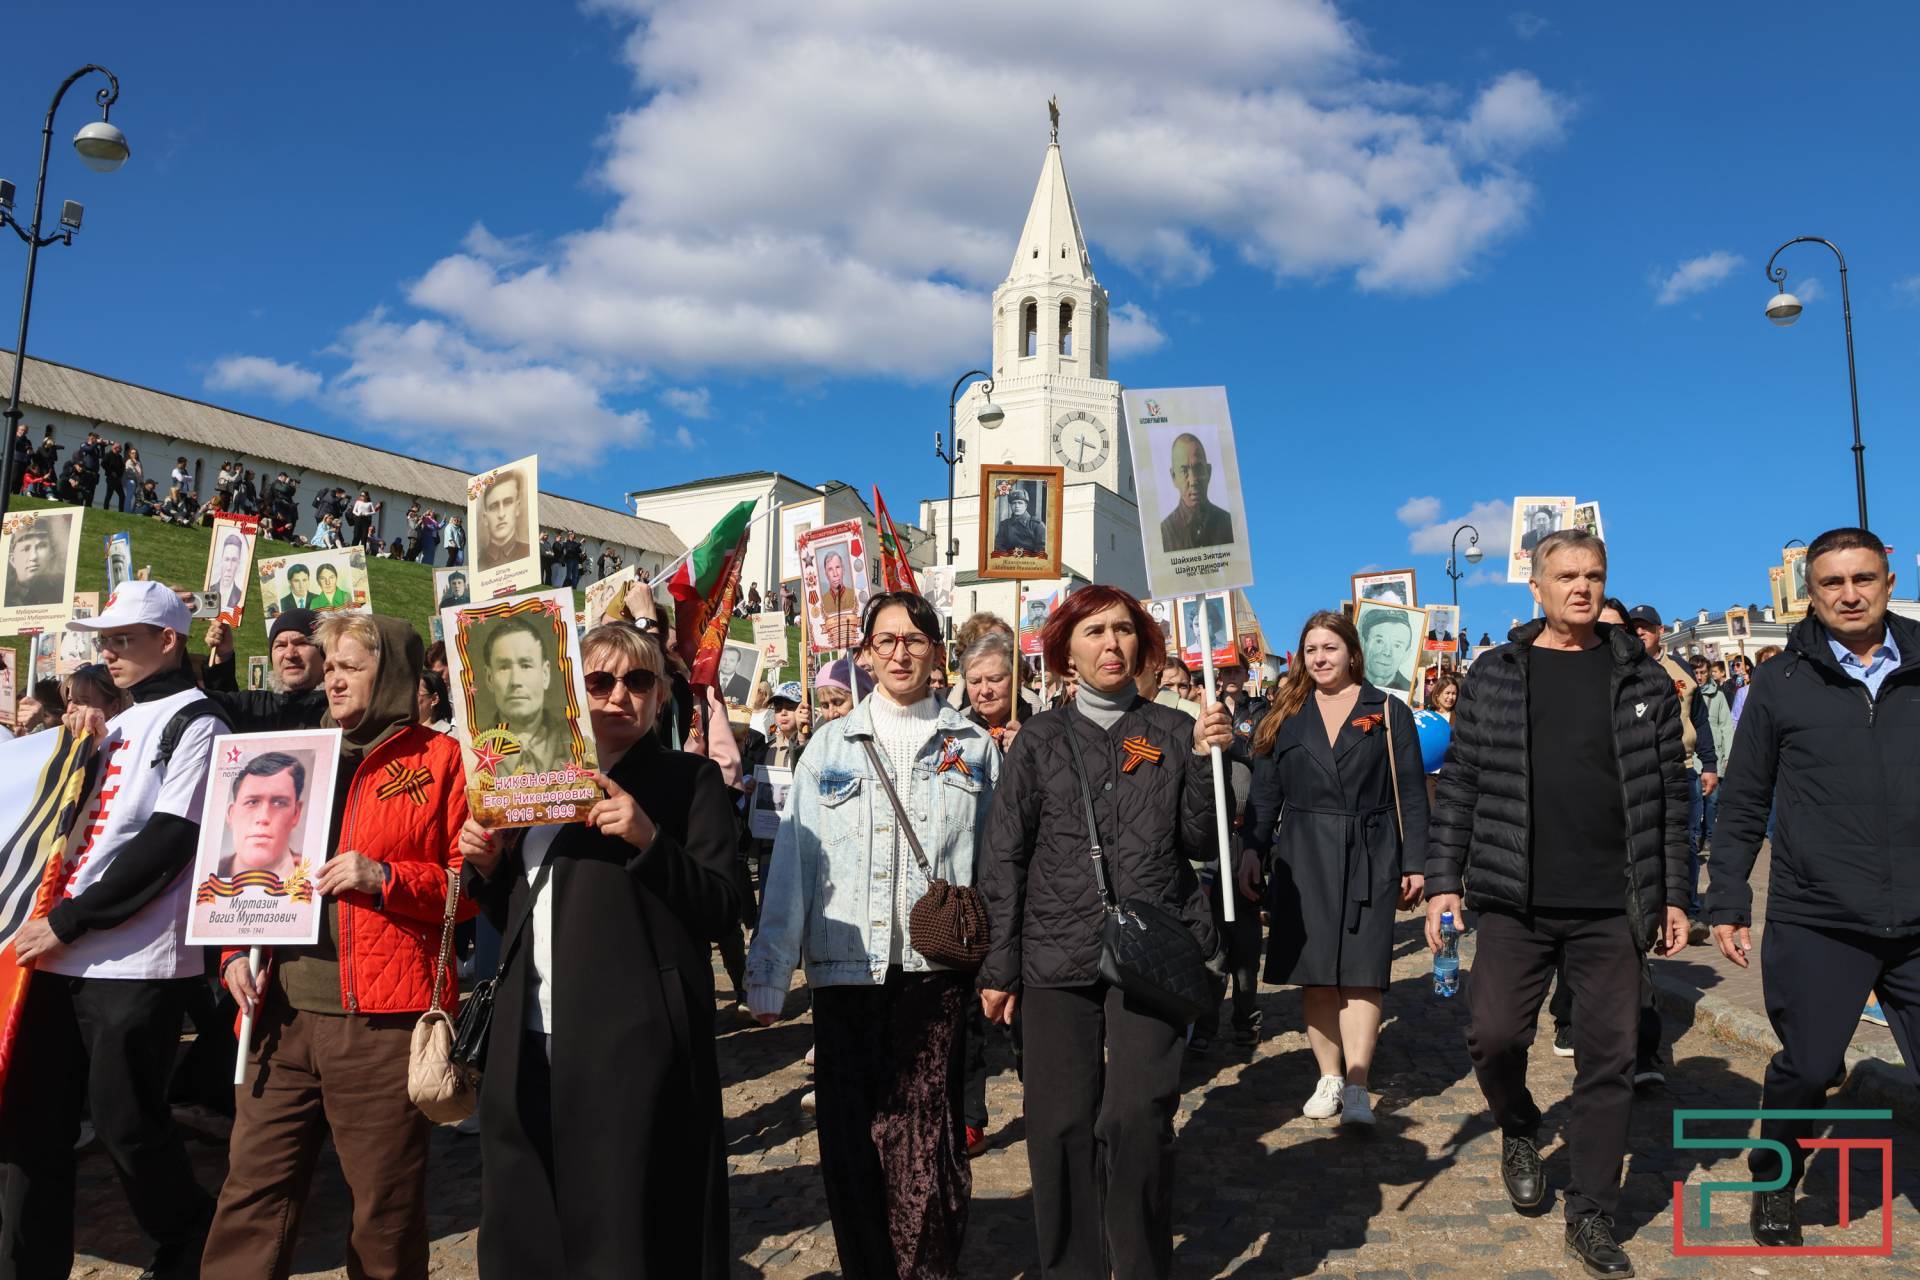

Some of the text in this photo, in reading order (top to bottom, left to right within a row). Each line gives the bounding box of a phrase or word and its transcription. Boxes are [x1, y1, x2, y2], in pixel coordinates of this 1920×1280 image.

[1171, 556, 1202, 565] Шайхиев
[1175, 561, 1229, 574] Шайхутдинович
[494, 771, 576, 790] НИКОНОРОВ
[483, 788, 594, 808] Егор Никонорович
[506, 809, 534, 822] 1915
[547, 805, 576, 818] 1999
[229, 898, 279, 912] Муртазин
[209, 912, 298, 925] Вагиз Муртазович
